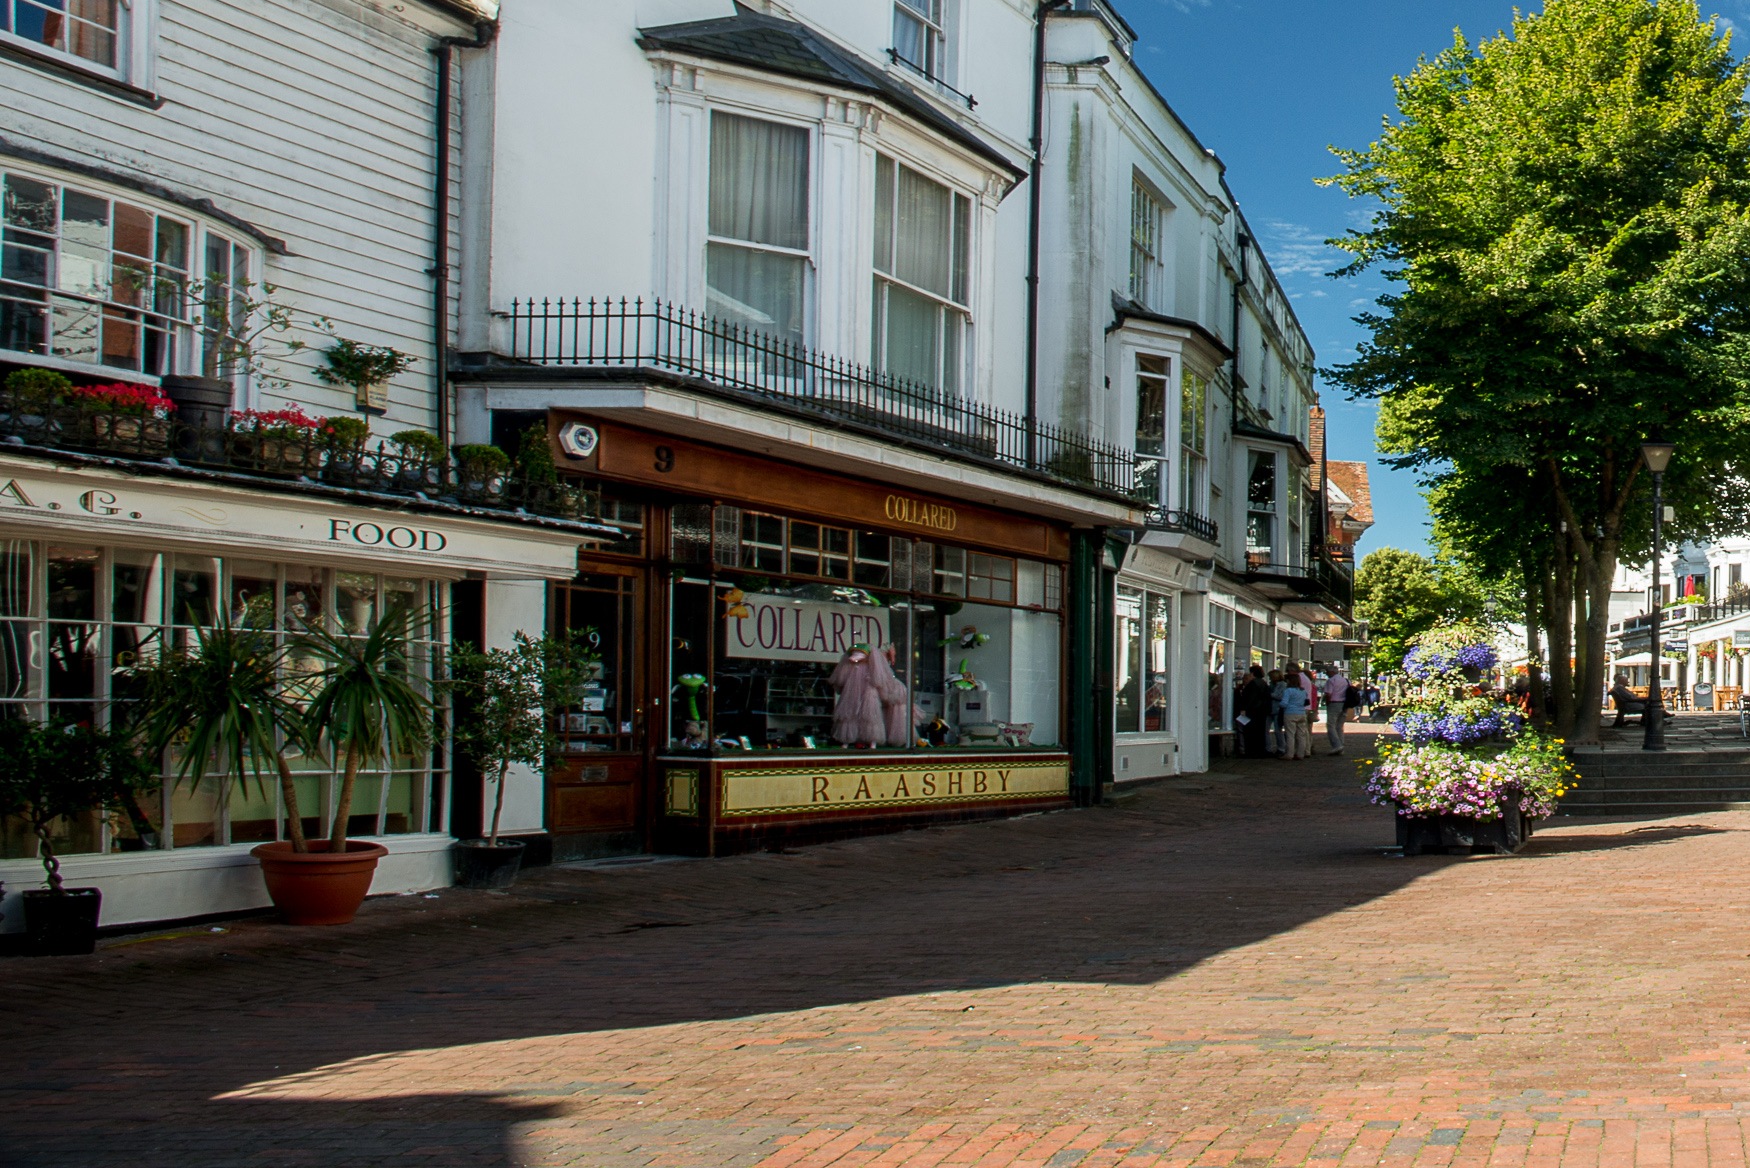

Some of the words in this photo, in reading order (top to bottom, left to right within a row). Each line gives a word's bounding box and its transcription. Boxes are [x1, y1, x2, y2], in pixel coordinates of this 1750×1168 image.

[653, 446, 676, 473] 9
[885, 494, 957, 531] COLLARED
[328, 518, 447, 552] FOOD
[588, 632, 600, 649] 9
[735, 604, 883, 654] COLLARED
